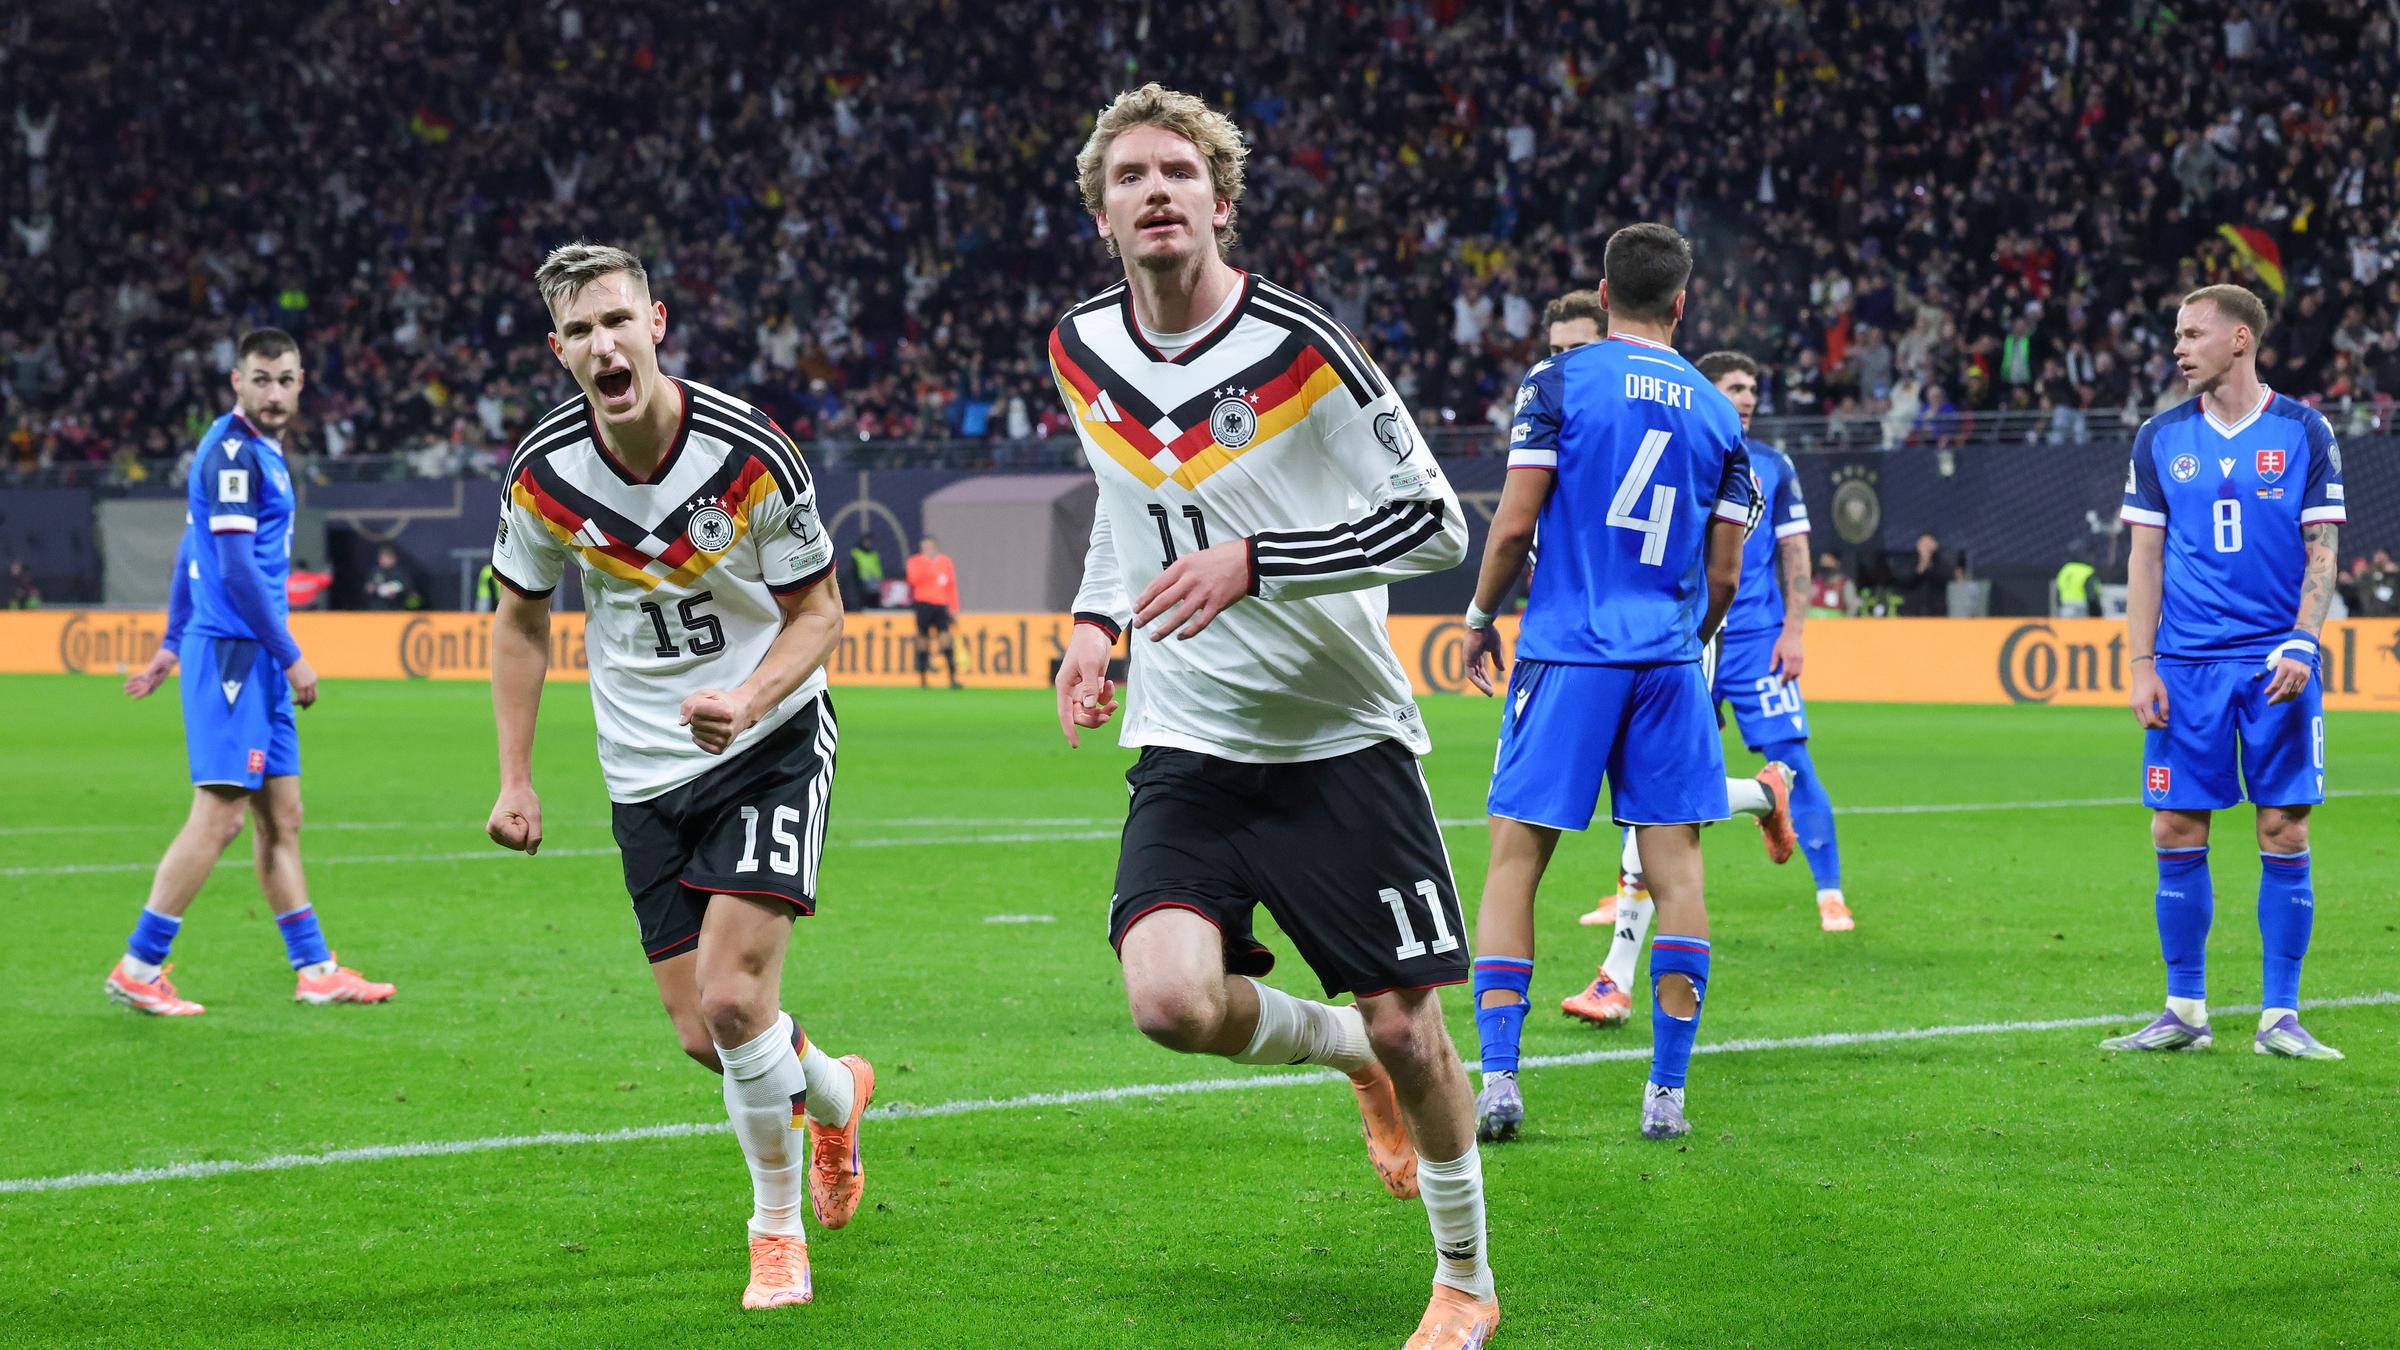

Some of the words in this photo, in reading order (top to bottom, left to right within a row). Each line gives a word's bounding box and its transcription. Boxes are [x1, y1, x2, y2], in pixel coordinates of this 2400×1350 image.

[1626, 373, 1694, 410] OBERT
[1605, 429, 1676, 566] 4
[2212, 499, 2242, 552] 8
[1147, 504, 1210, 571] 11
[640, 590, 726, 657] 15
[1756, 674, 1800, 717] 20
[736, 805, 799, 876] 15
[1378, 879, 1459, 960] 11
